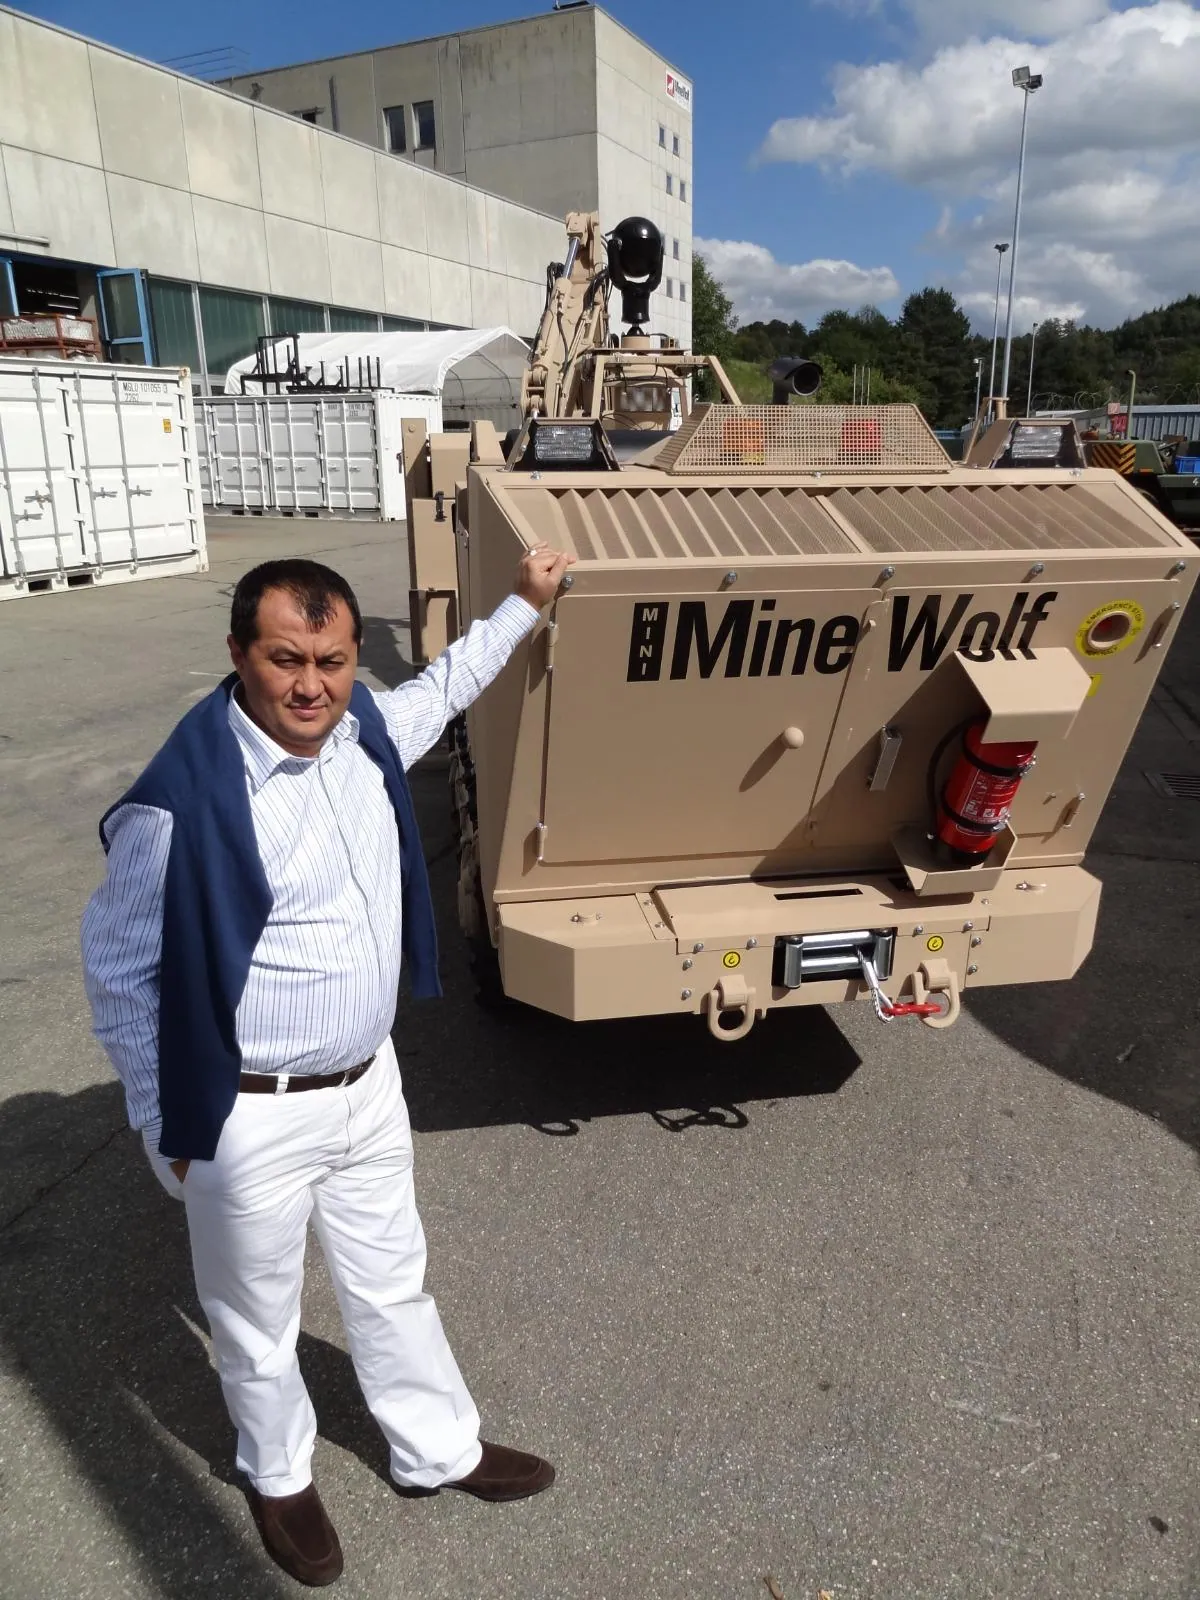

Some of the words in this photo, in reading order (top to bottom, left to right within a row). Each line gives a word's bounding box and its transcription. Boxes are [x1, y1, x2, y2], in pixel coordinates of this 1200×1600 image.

[640, 607, 659, 676] MINI
[669, 599, 860, 681] Mine
[887, 591, 1059, 673] Wolf
[1085, 602, 1133, 625] EMERGENCY
